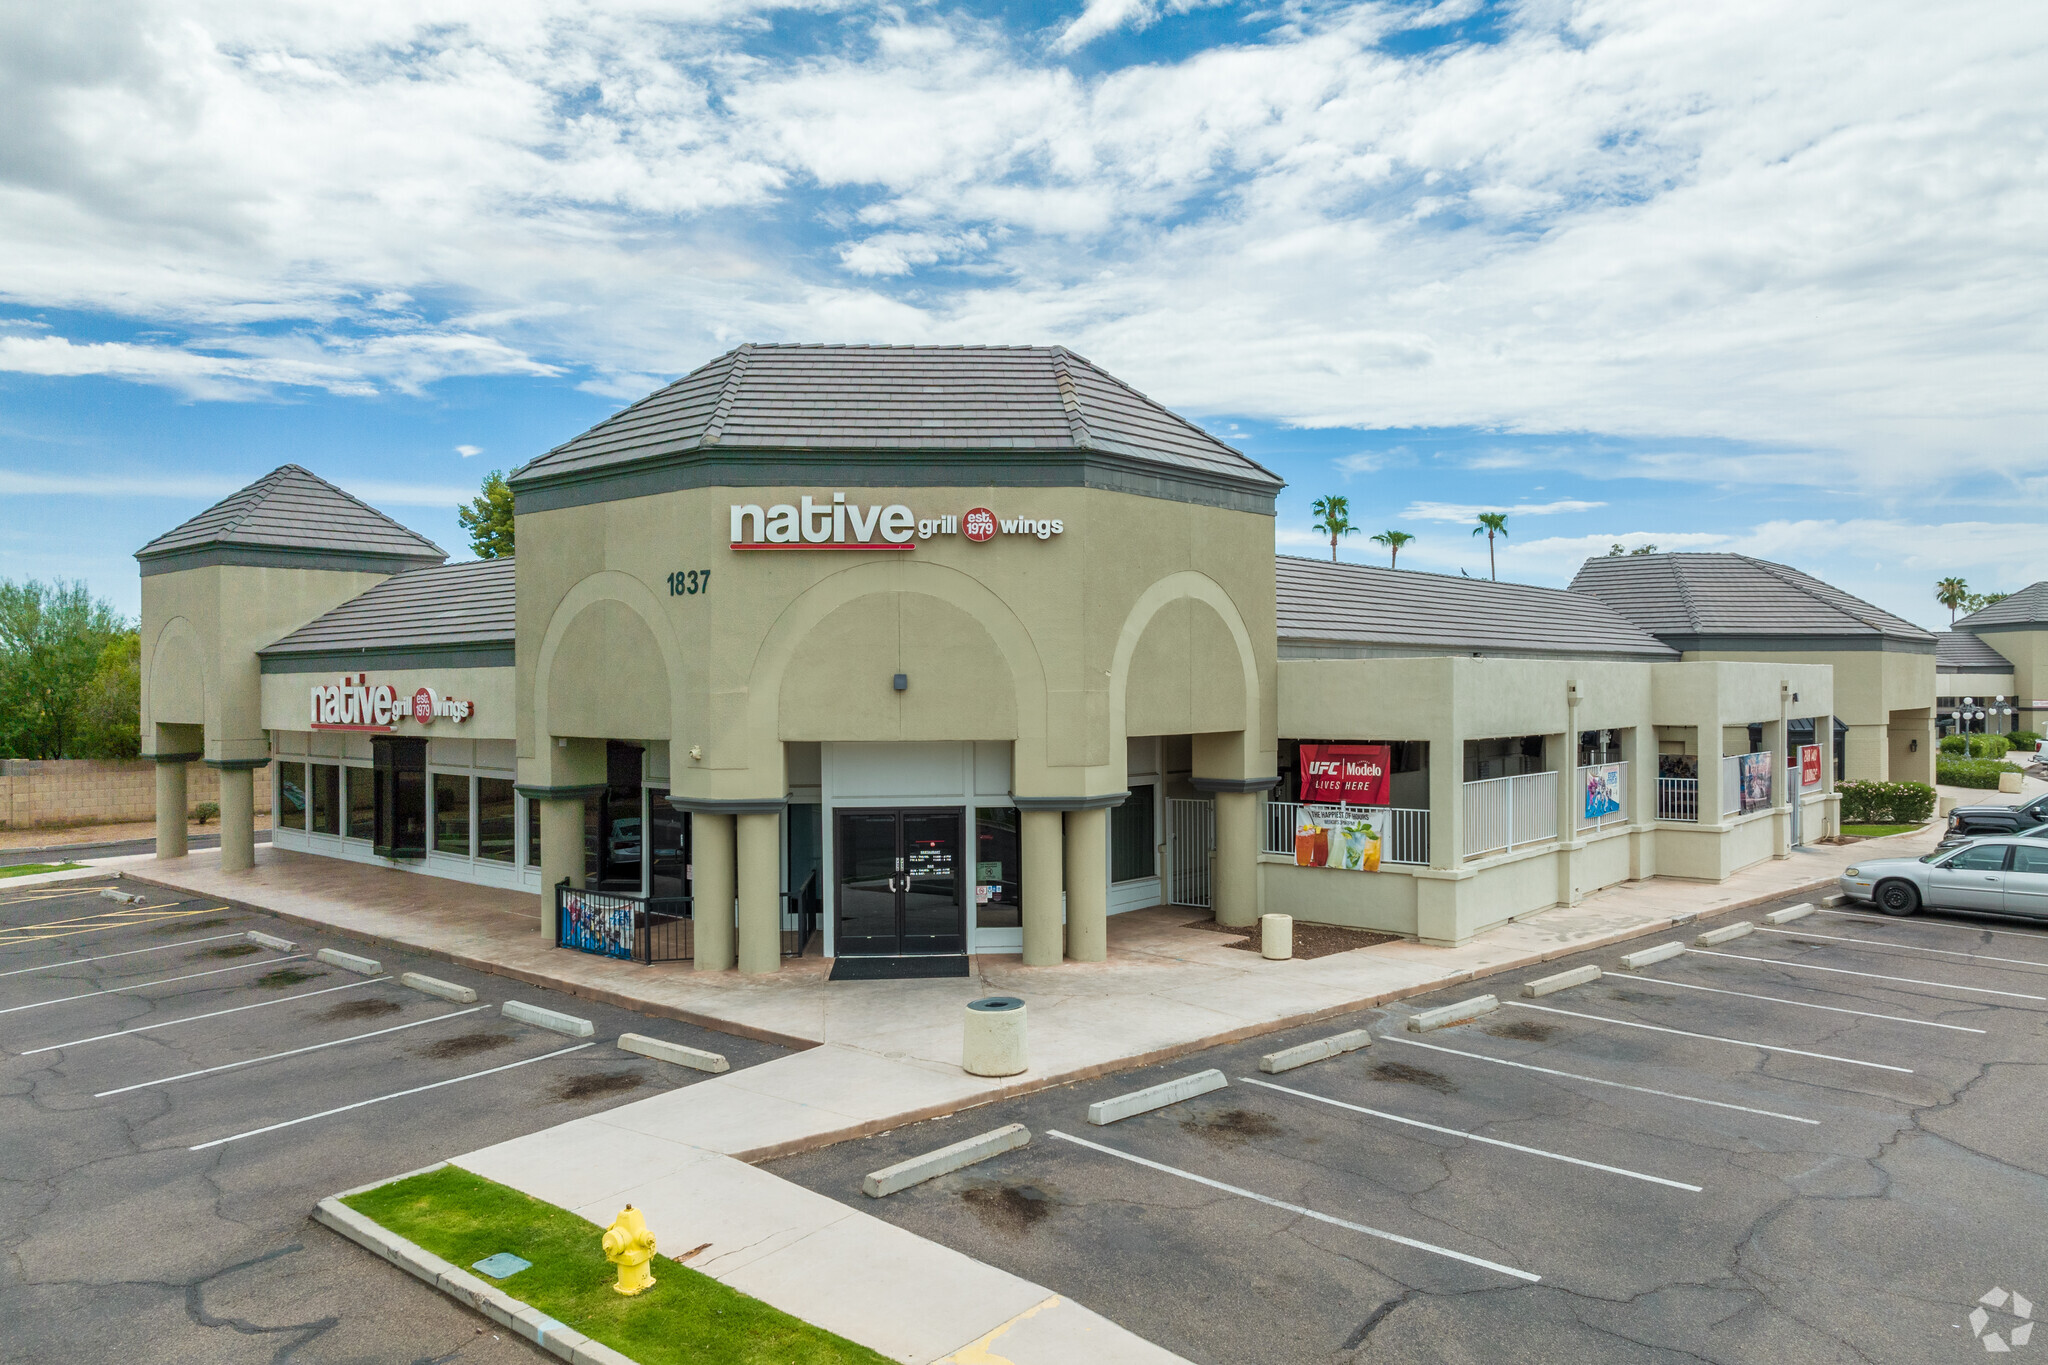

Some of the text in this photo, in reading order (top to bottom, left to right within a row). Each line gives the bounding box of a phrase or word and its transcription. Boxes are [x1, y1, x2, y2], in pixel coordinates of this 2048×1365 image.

[730, 492, 1064, 543] native grill wings
[967, 511, 992, 523] est.
[966, 523, 994, 535] 1979
[667, 569, 711, 597] 1837
[310, 674, 471, 726] native grill wings
[416, 704, 430, 717] 1979
[1309, 761, 1382, 777] UFC Modelo
[1315, 780, 1370, 791] LIVES HERE
[1311, 811, 1370, 821] THE HAPPIEST OF HOURS
